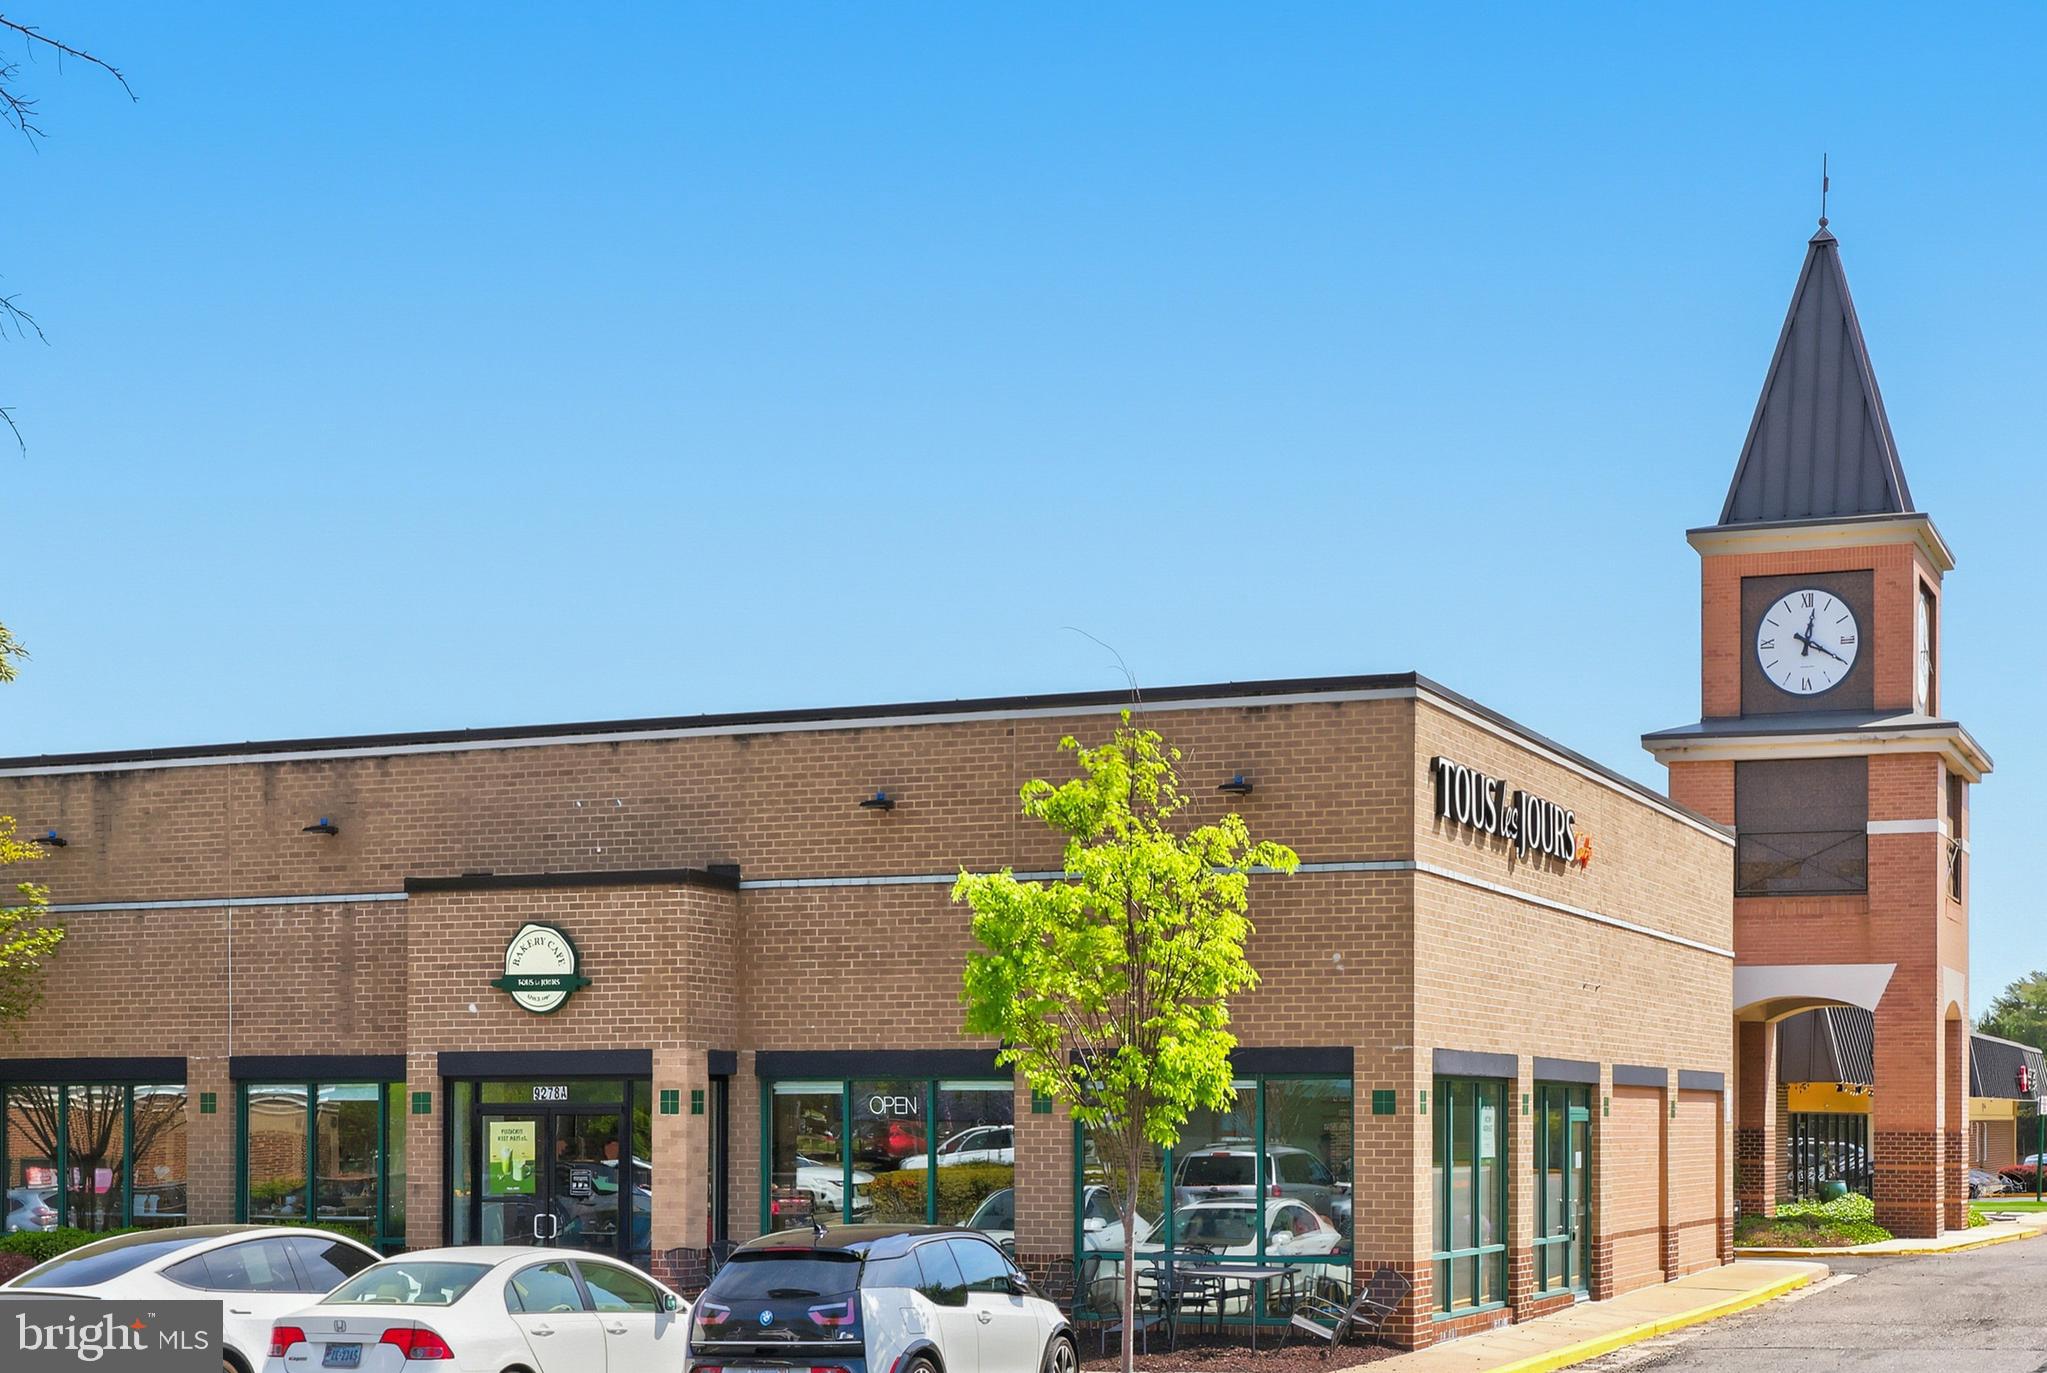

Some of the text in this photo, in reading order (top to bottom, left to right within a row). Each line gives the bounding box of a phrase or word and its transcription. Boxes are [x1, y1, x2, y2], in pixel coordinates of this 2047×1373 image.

[1801, 592, 1814, 608] XII
[1435, 757, 1575, 862] TOUS les JOURS
[512, 936, 566, 967] BAKERY CAFE
[869, 1095, 917, 1115] OPEN
